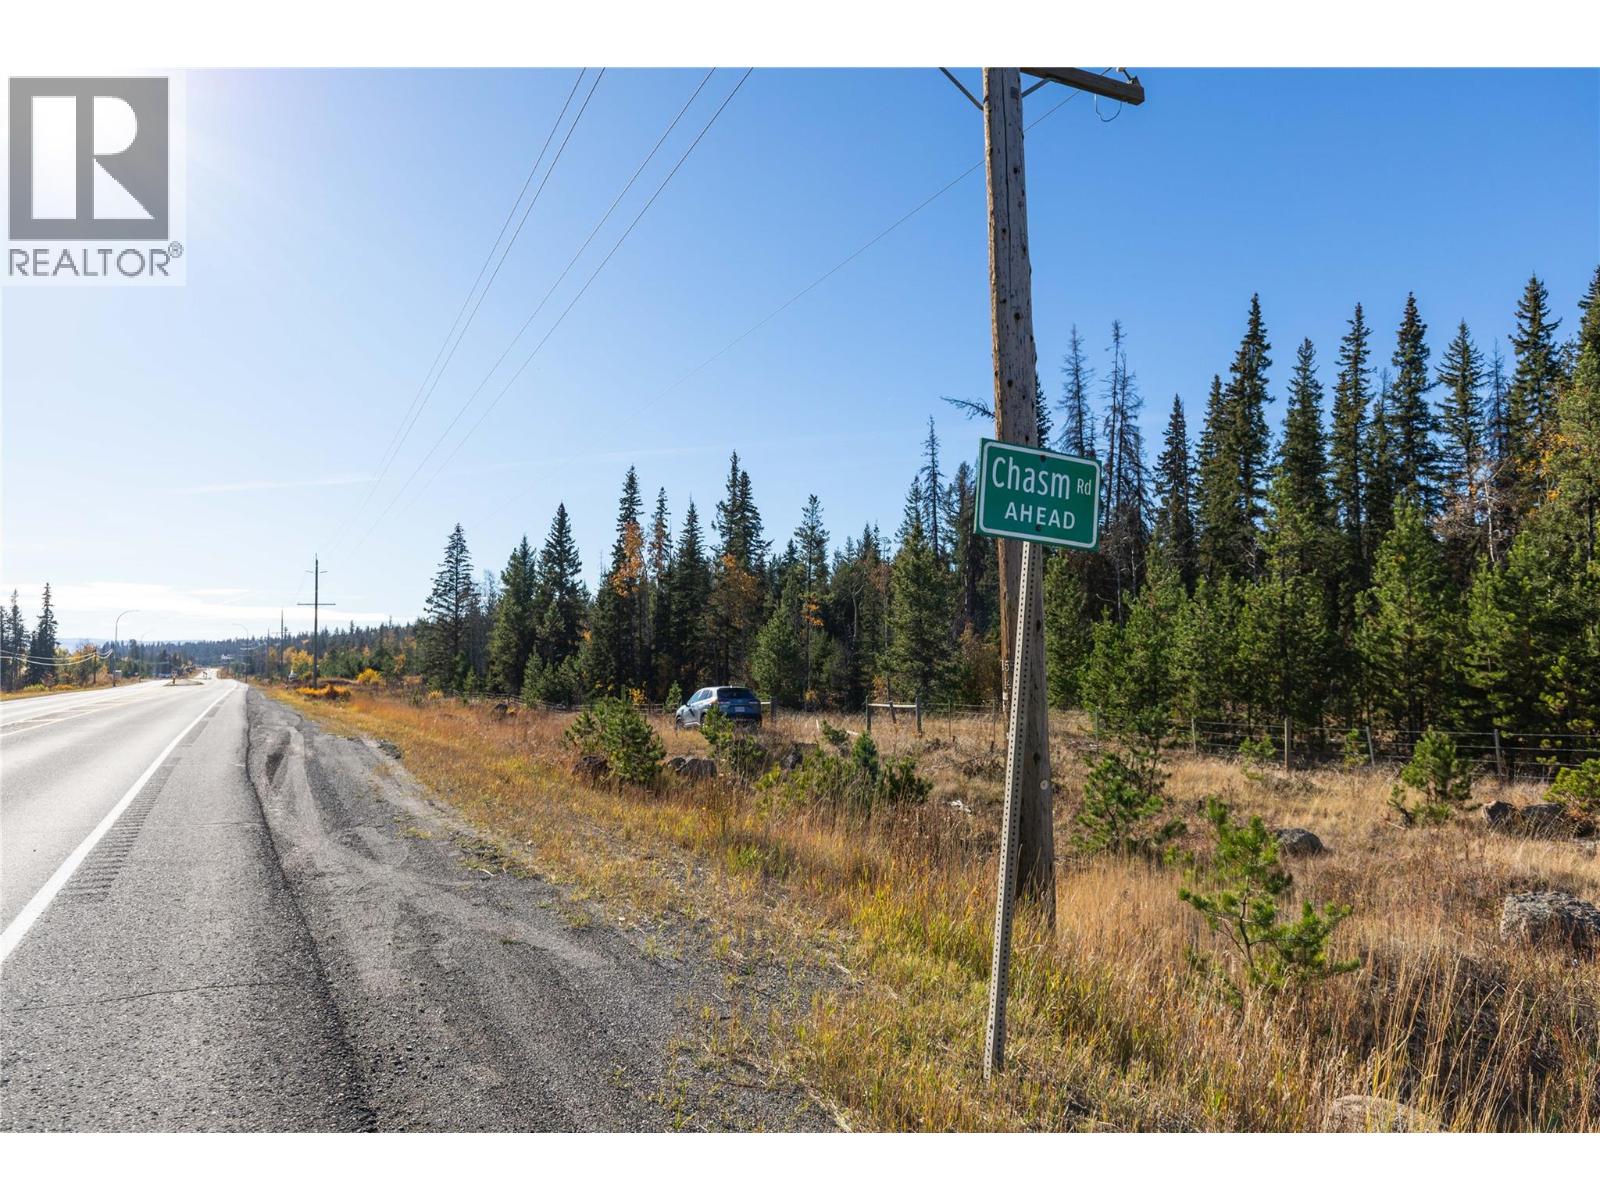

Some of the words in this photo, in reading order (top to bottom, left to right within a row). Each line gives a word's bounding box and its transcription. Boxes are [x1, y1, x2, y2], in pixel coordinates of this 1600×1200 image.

[991, 456, 1070, 500] Chasm
[1076, 478, 1092, 496] Rd
[1004, 501, 1076, 530] AHEAD
